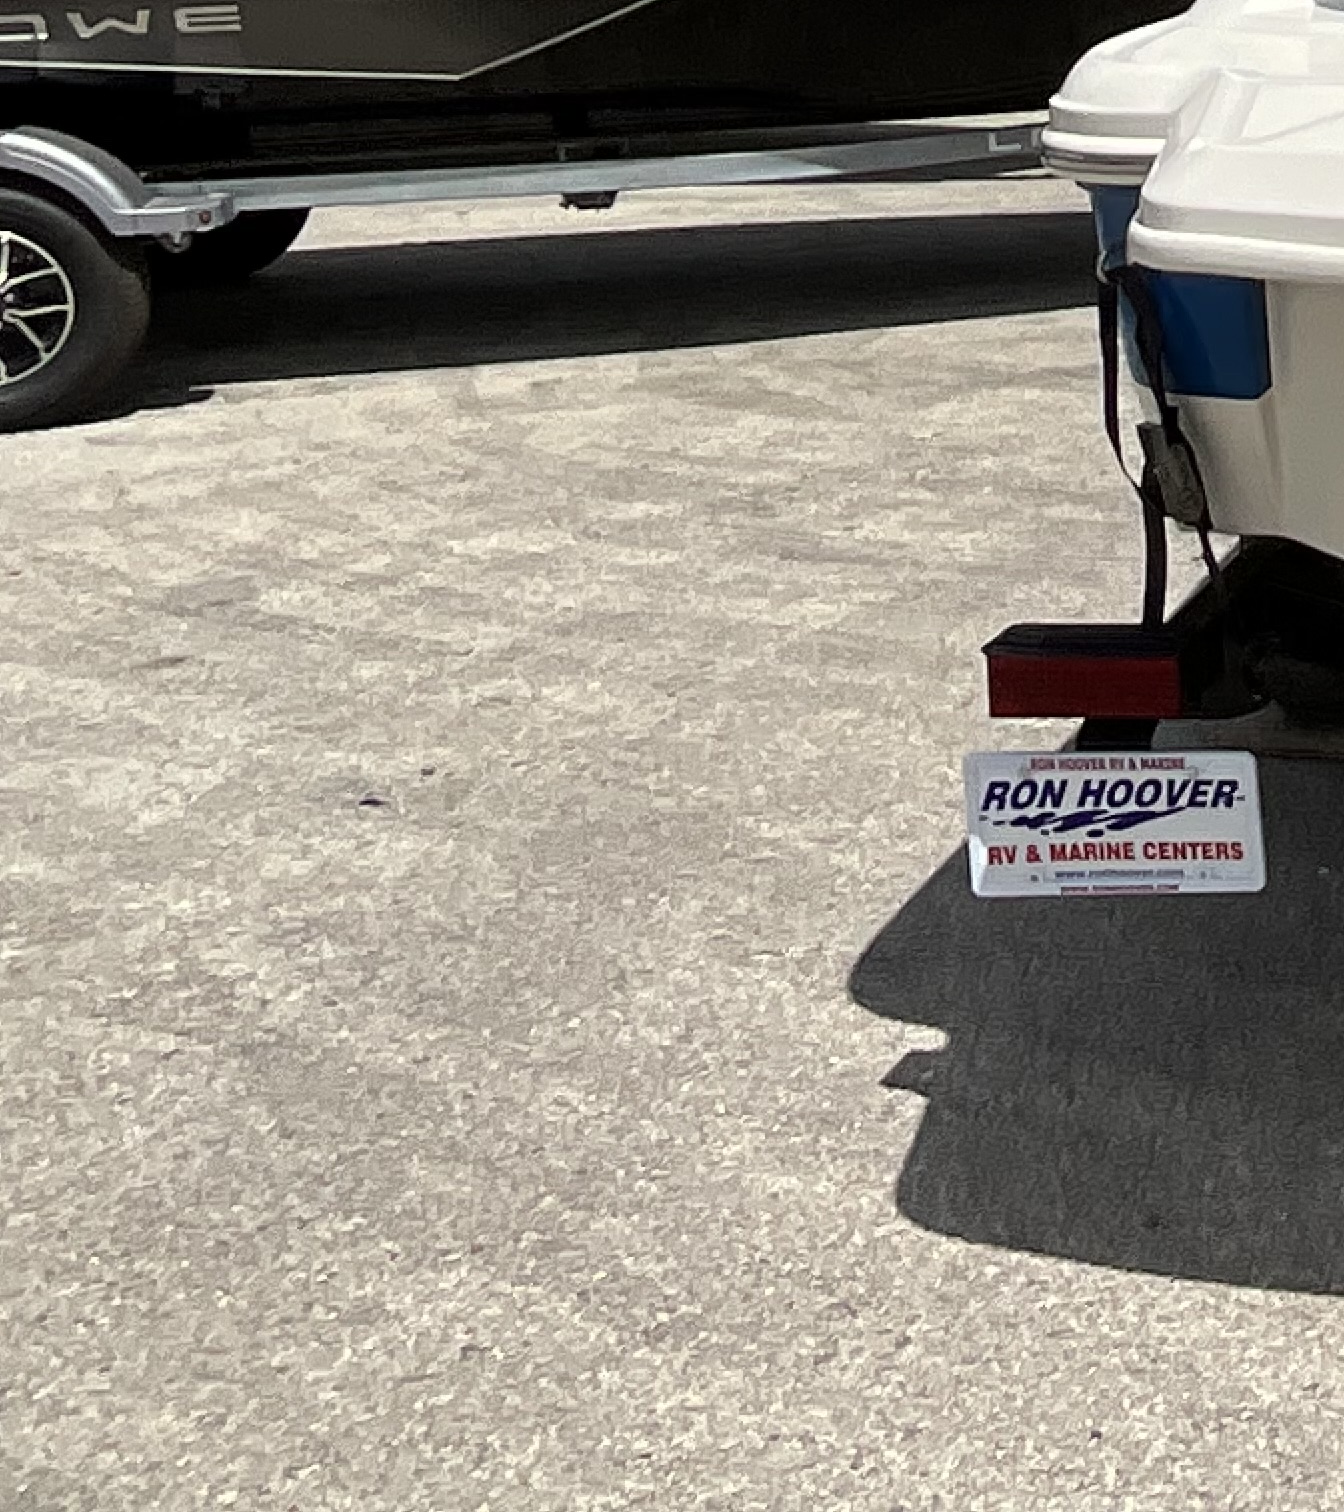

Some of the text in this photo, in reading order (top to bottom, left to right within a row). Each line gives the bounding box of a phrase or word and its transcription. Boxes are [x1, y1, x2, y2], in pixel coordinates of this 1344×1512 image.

[981, 778, 1241, 811] RON HOOVER
[988, 841, 1245, 866] RV & MARINE CENTERS
